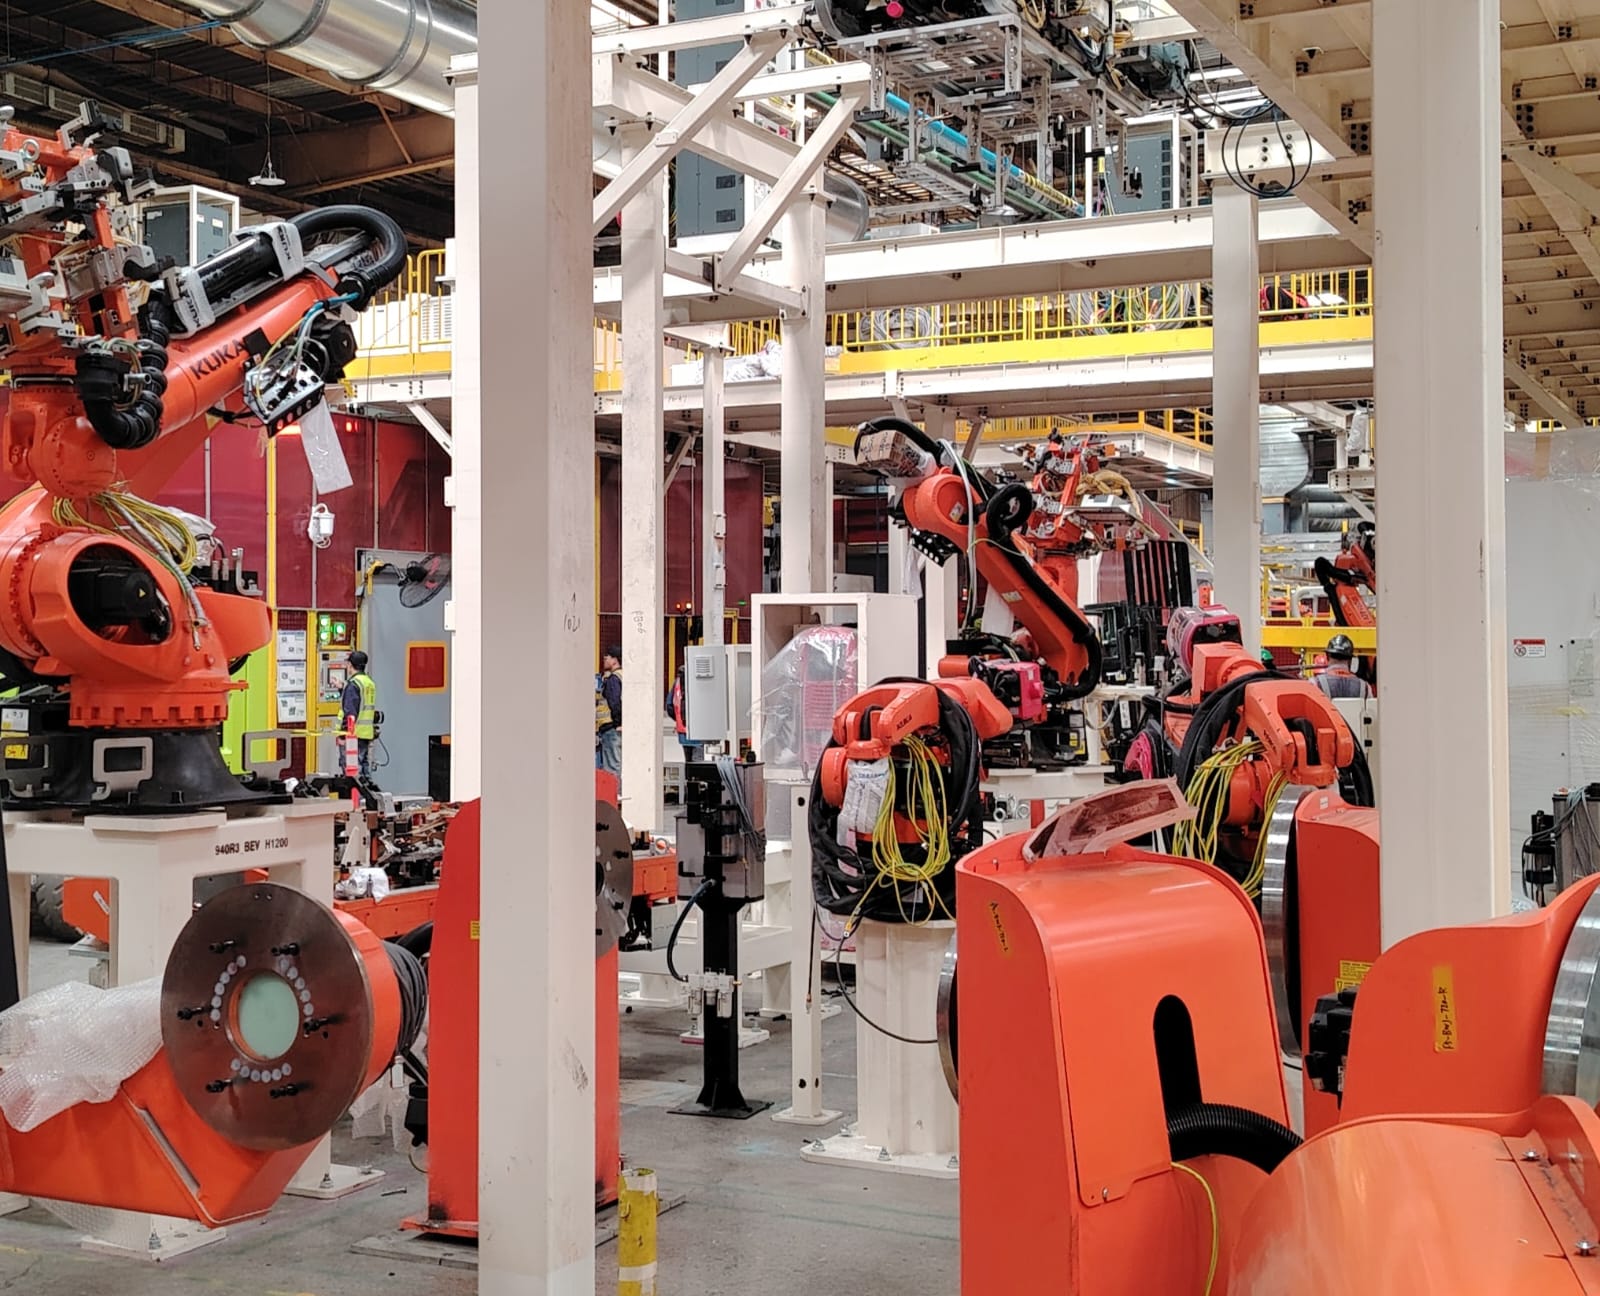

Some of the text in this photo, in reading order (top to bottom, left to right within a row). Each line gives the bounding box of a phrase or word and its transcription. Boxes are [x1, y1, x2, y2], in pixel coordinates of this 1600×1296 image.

[190, 339, 250, 380] KUKA
[244, 840, 260, 853] BEV
[264, 837, 289, 850] H1200
